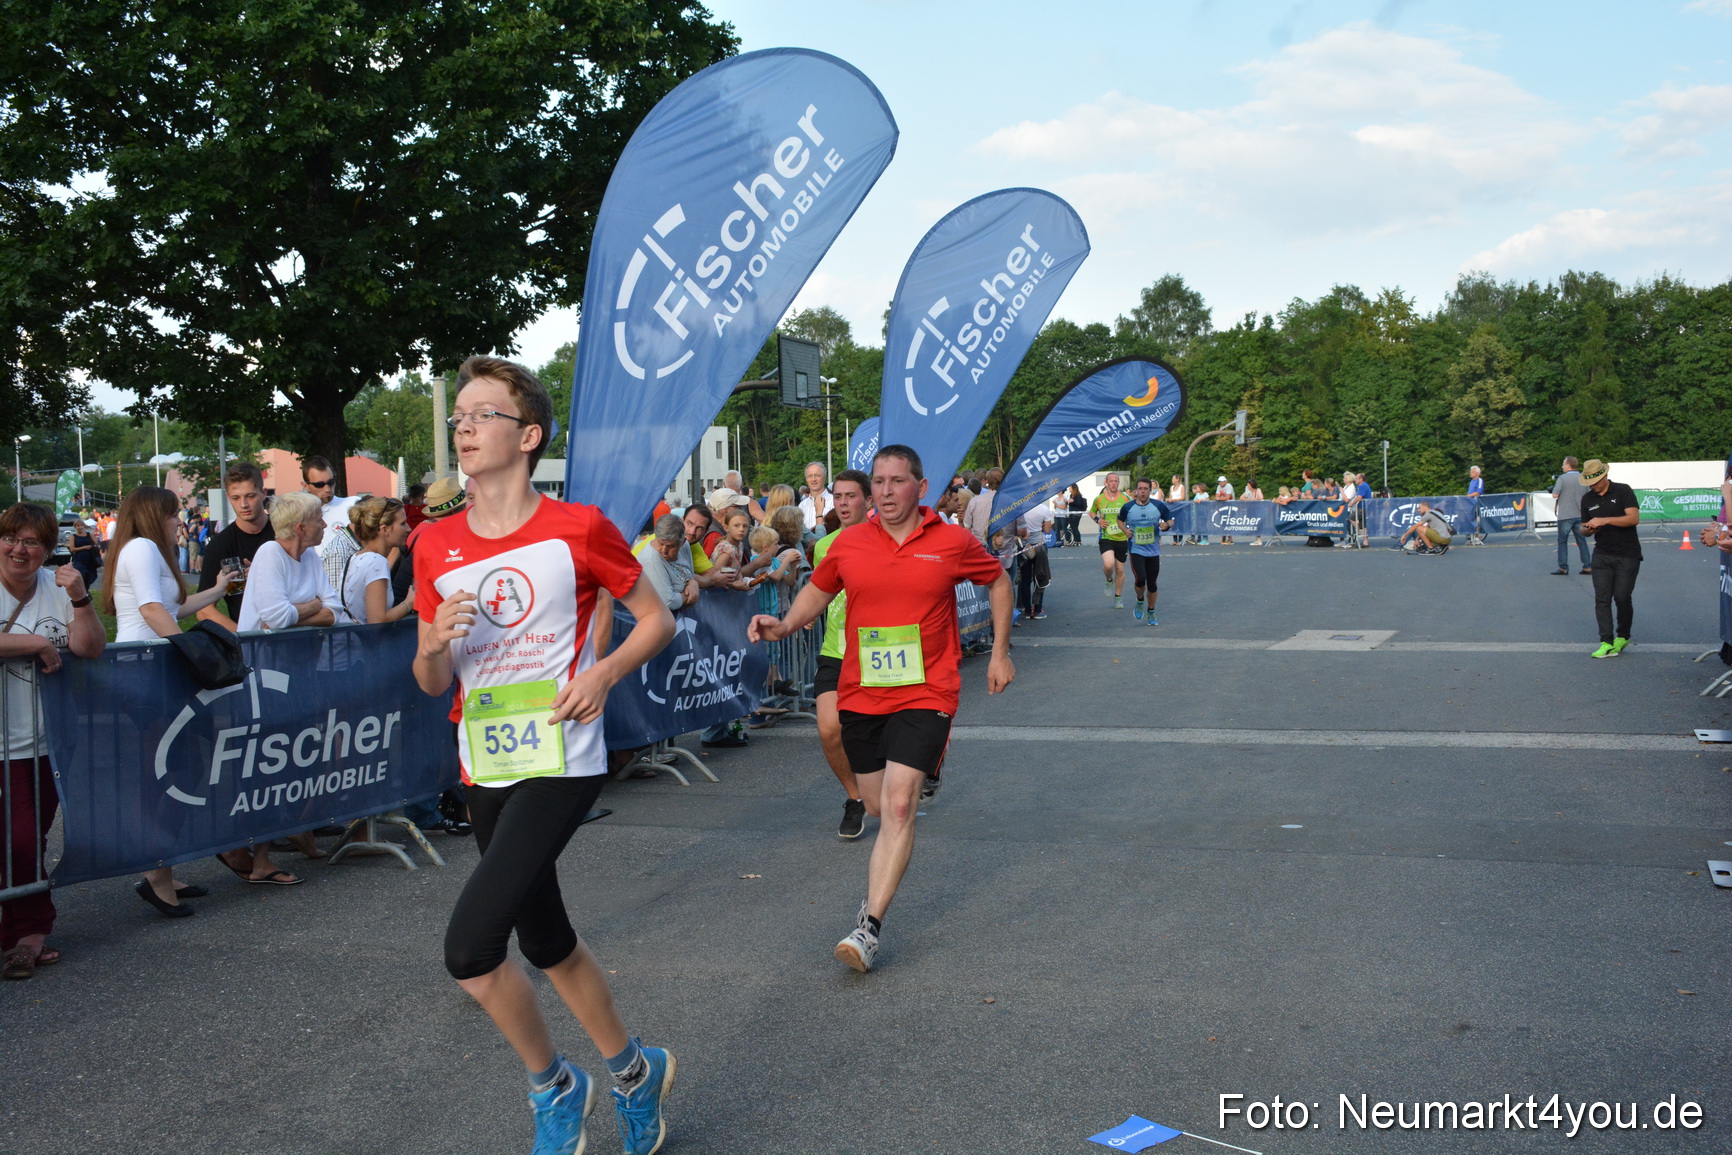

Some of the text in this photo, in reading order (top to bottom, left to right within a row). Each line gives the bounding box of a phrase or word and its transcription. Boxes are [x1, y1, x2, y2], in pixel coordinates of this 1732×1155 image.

[653, 104, 824, 340] Fischer
[713, 148, 844, 338] AUTOMOBILE
[930, 223, 1040, 388] Fischer
[970, 252, 1054, 384] AUTOMOBILE
[1020, 410, 1136, 478] Frischmann
[1094, 401, 1176, 450] Druck und Medien
[1220, 515, 1261, 526] Fischer
[1280, 510, 1328, 522] Frischmann
[1480, 506, 1514, 518] Frischmann
[1674, 494, 1722, 504] GESUNDHE
[48, 635, 67, 645] GHT
[871, 650, 906, 670] 511
[665, 645, 747, 691] Fischer
[674, 682, 744, 712] AUTOMOBILE
[209, 708, 401, 786] Fischer
[485, 720, 541, 755] 534
[230, 760, 388, 816] AUTOMOBILE
